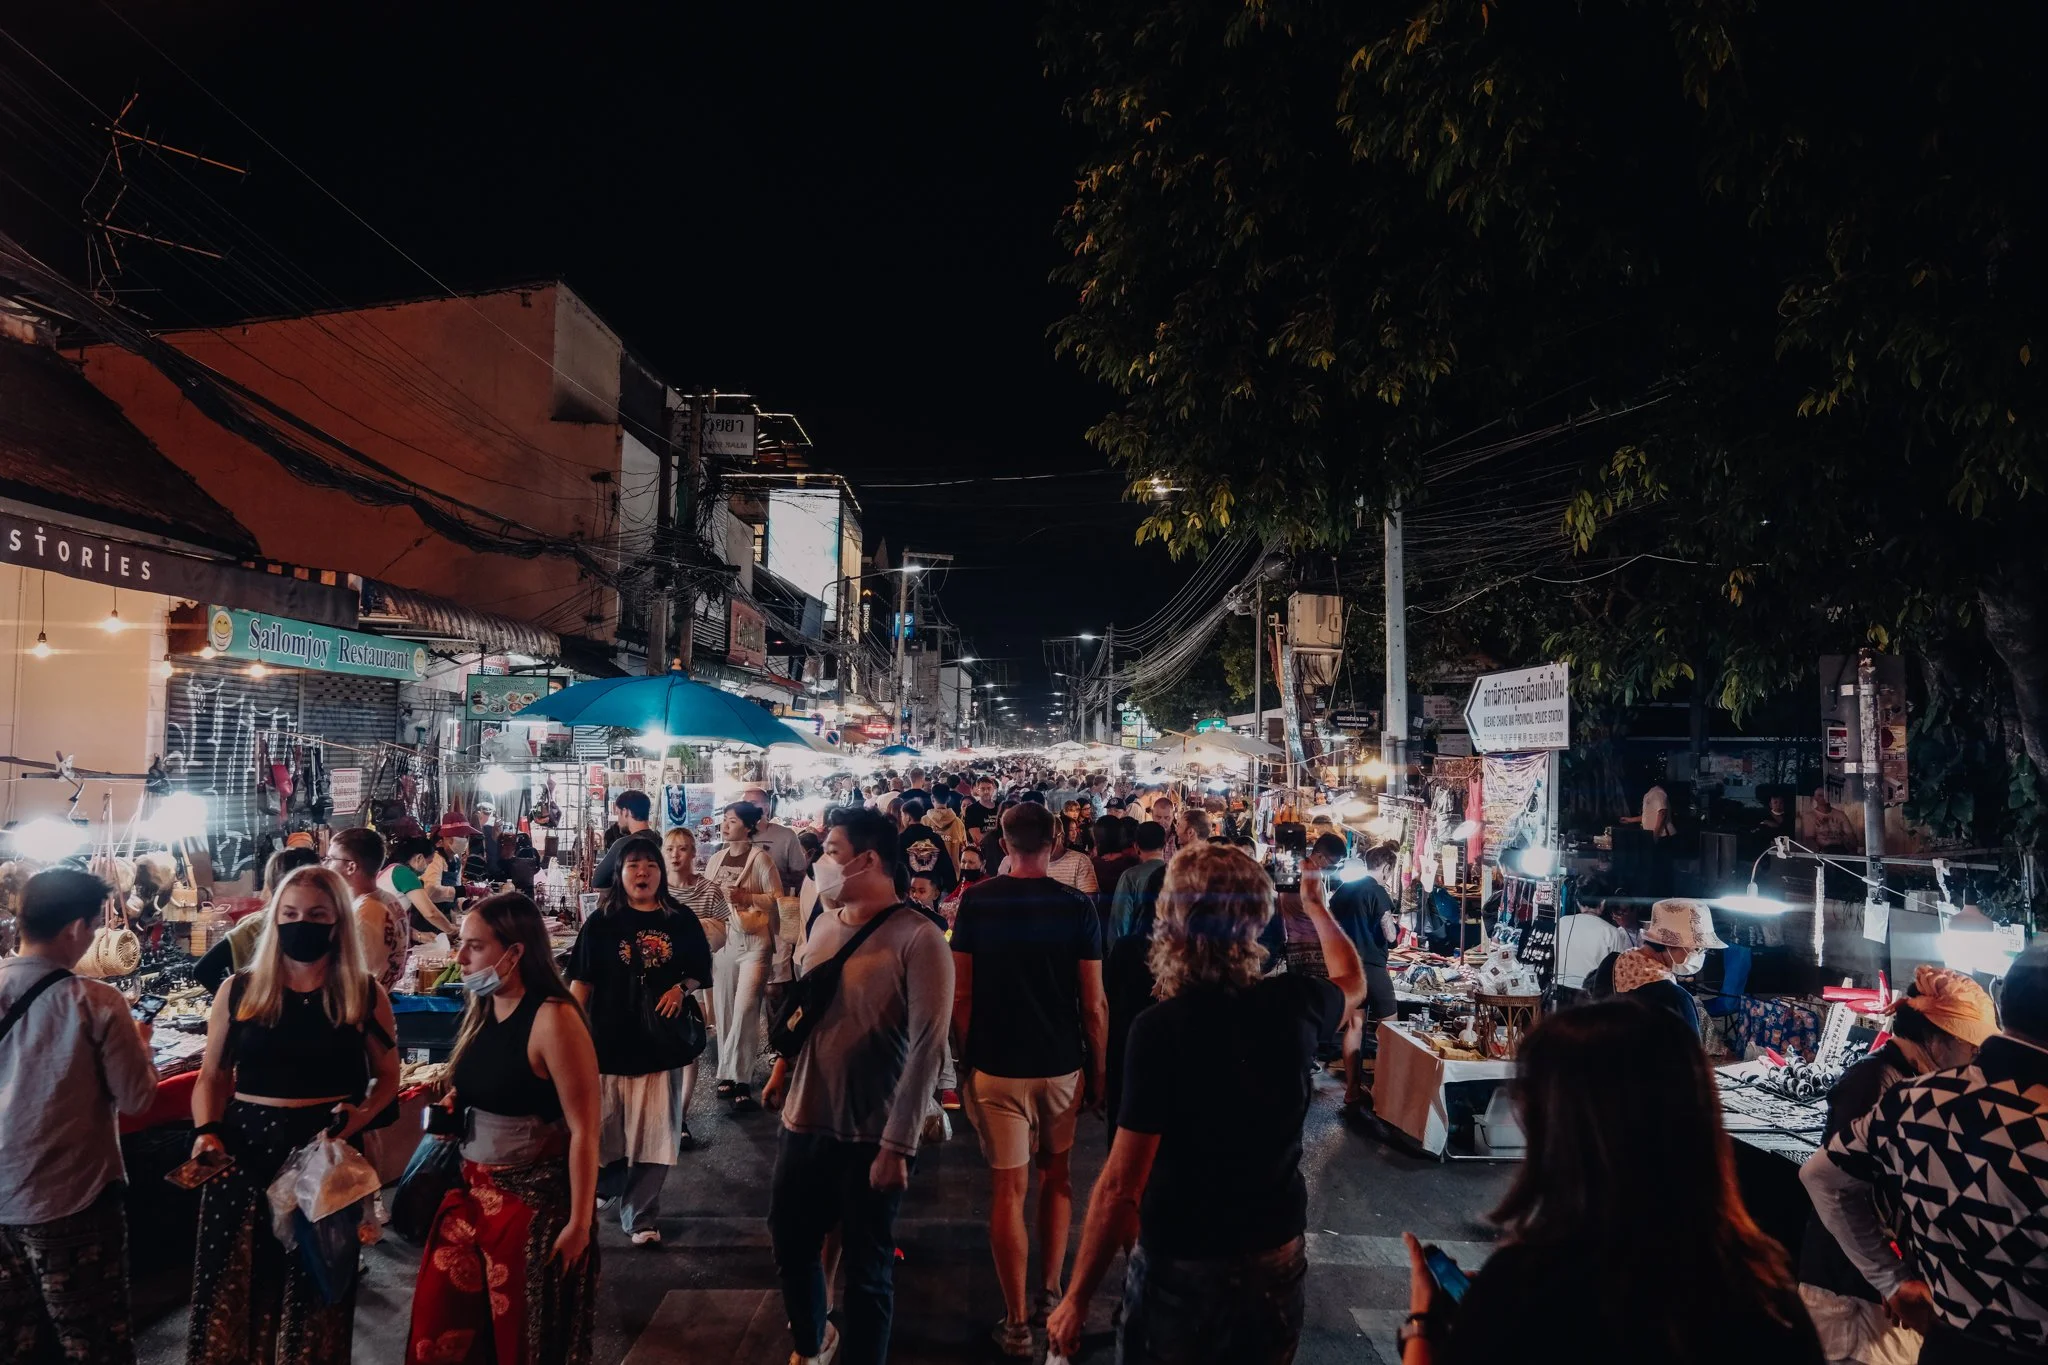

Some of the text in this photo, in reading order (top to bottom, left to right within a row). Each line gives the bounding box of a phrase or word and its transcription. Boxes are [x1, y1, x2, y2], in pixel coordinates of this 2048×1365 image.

[9, 526, 150, 580] STORIES
[249, 618, 410, 671] Sailomjoy Restaurant
[1535, 710, 1548, 724] POLICE
[1548, 709, 1564, 723] STATION
